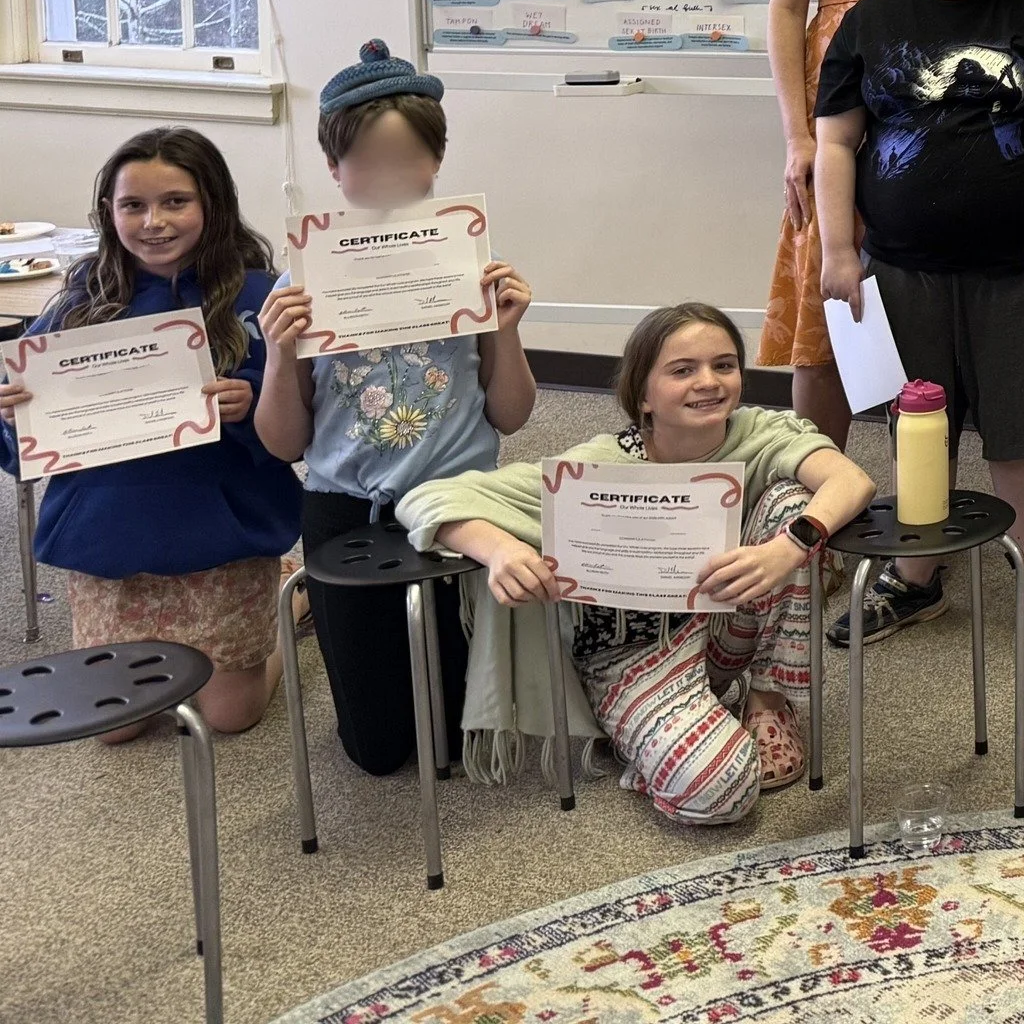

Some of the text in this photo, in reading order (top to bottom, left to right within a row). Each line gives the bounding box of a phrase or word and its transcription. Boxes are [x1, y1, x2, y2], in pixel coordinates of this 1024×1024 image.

[623, 18, 661, 26] ASSIGNED
[696, 23, 732, 32] INTERSEX
[339, 228, 440, 247] CERTIFICATE
[59, 342, 160, 368] CERTIFICATE
[589, 492, 691, 504] CERTIFICATE
[656, 684, 675, 701] LET
[720, 762, 739, 784] LET
